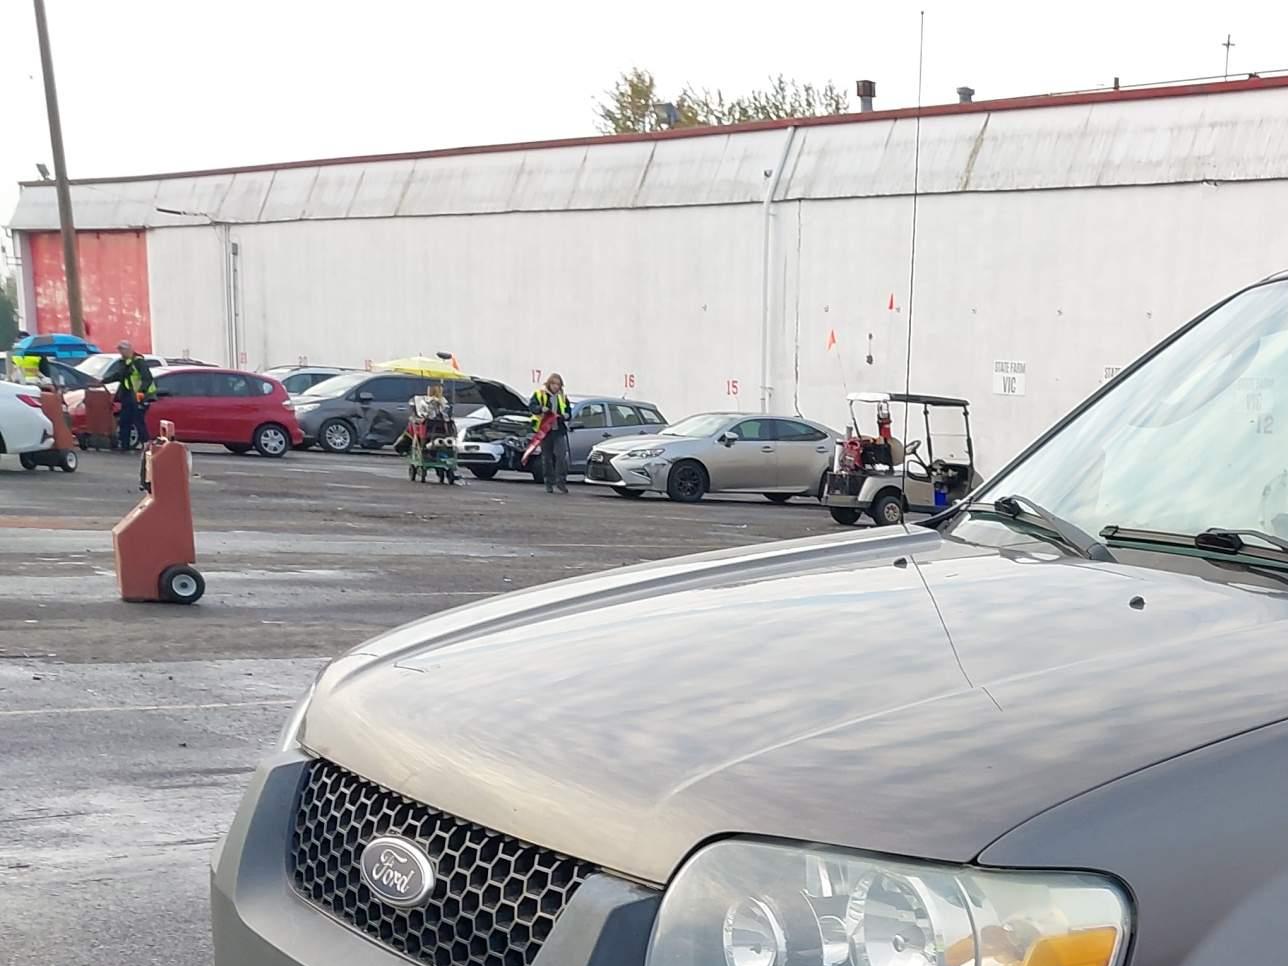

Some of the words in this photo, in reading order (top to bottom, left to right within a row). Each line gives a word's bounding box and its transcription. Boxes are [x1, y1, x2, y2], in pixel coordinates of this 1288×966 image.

[994, 361, 1009, 373] STATE
[531, 370, 542, 383] 17
[624, 374, 635, 388] 16
[727, 381, 739, 396] 15
[1002, 376, 1017, 393] VIC
[372, 849, 415, 893] Ford
